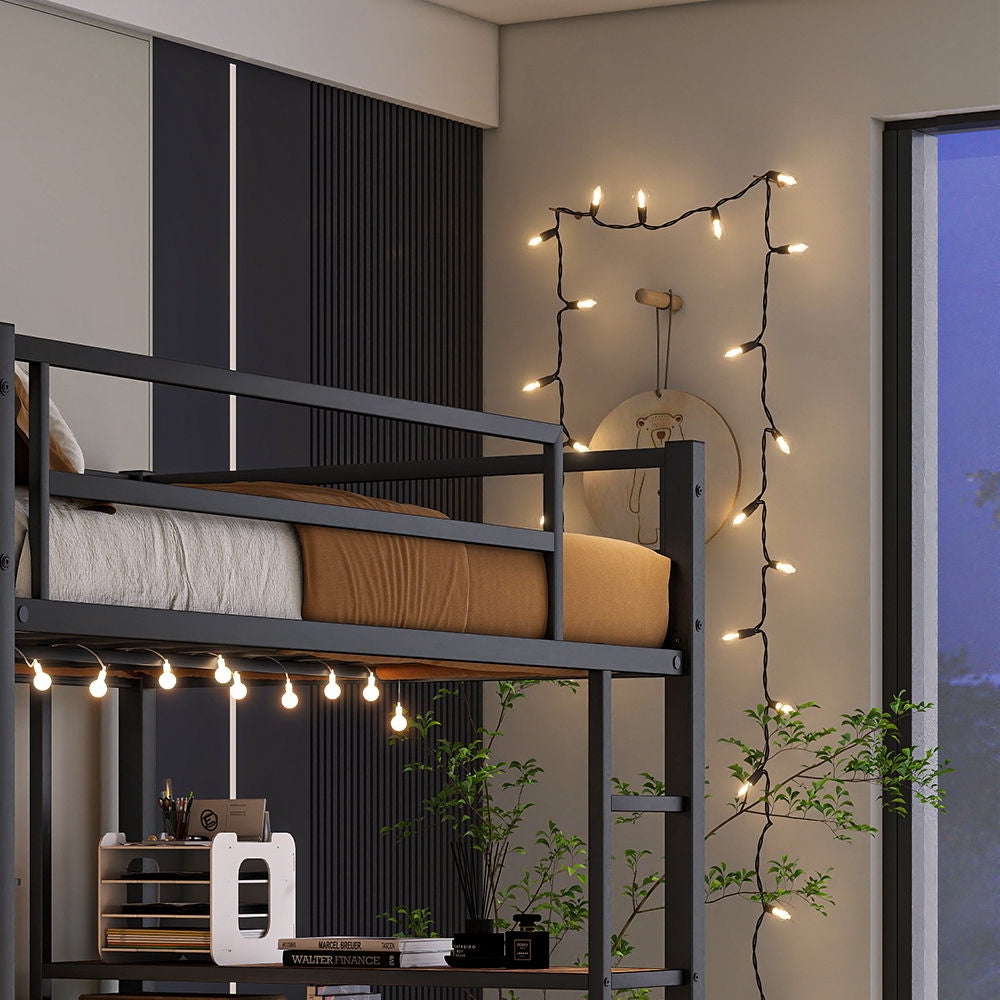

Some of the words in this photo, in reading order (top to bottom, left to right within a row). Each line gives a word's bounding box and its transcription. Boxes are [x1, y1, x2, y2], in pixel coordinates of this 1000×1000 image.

[318, 941, 340, 949] MARCEL
[340, 941, 362, 950] BREUER
[291, 954, 334, 965] WALTER
[334, 955, 381, 966] FINANCE
